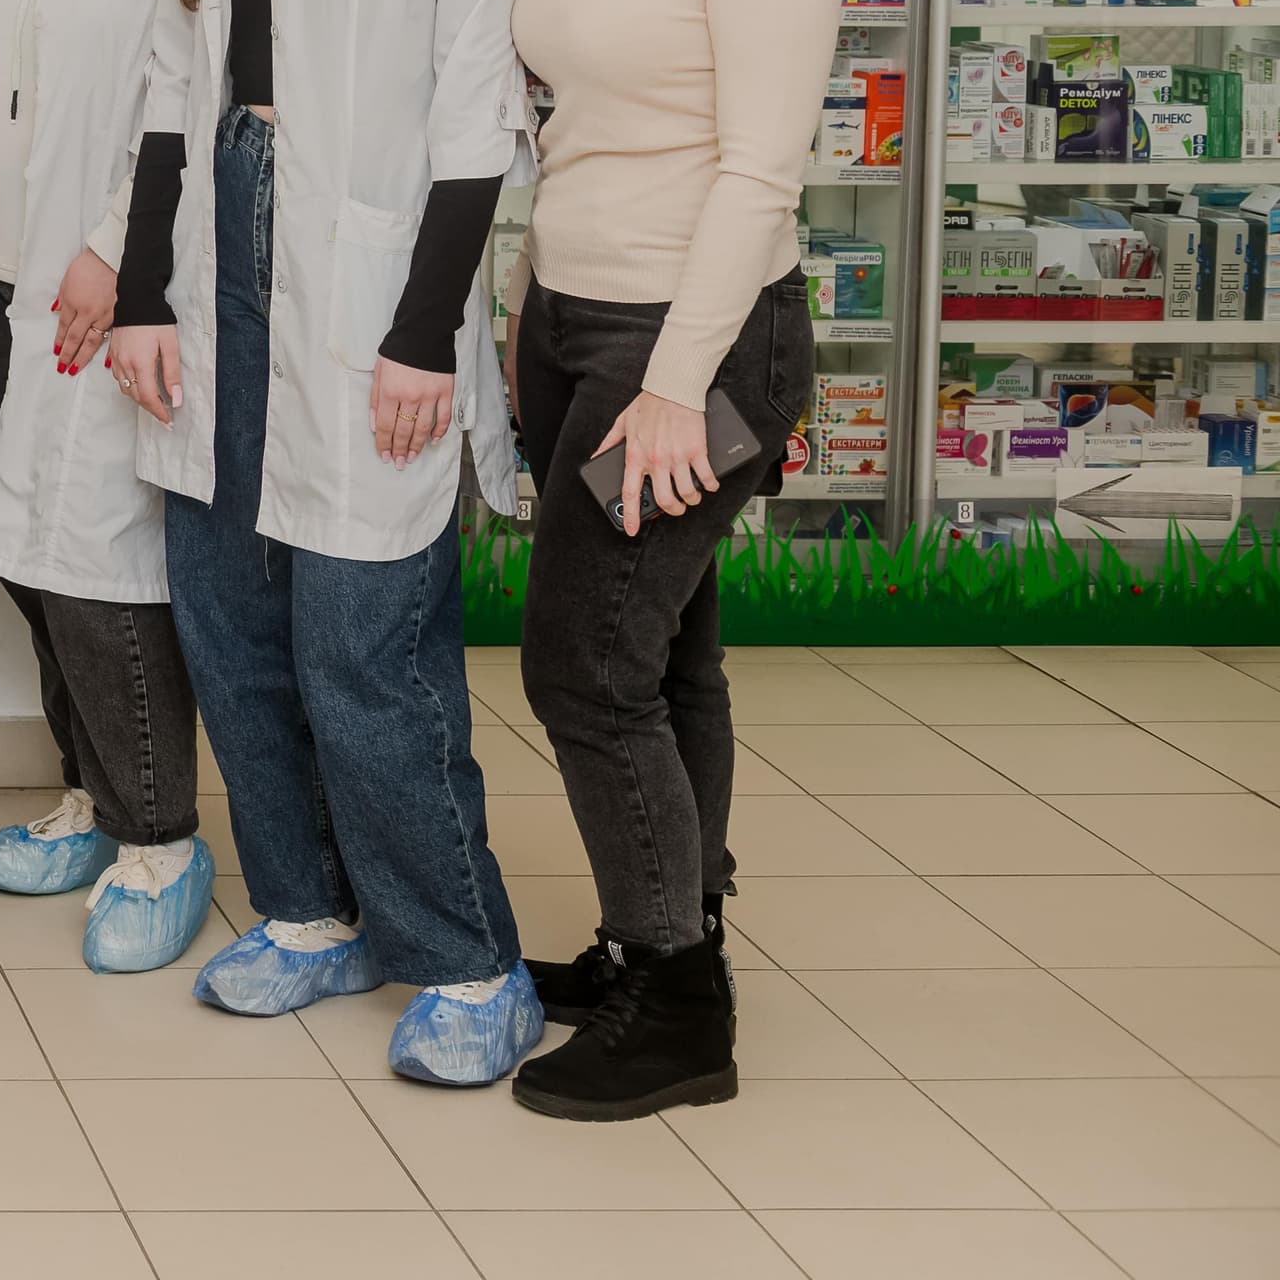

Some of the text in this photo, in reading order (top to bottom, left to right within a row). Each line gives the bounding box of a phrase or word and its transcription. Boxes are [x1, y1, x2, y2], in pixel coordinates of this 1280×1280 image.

[1136, 70, 1167, 79] ЛІНЕКС
[1060, 87, 1121, 99] Ремедіум
[1059, 99, 1097, 108] DETOX
[1152, 113, 1192, 124] ЛІНЕКС
[996, 385, 1030, 393] ФЕМІНА
[831, 439, 882, 449] ЕКСТРАТЕРМ
[1012, 436, 1067, 446] Феміност Уро
[959, 504, 971, 519] 8
